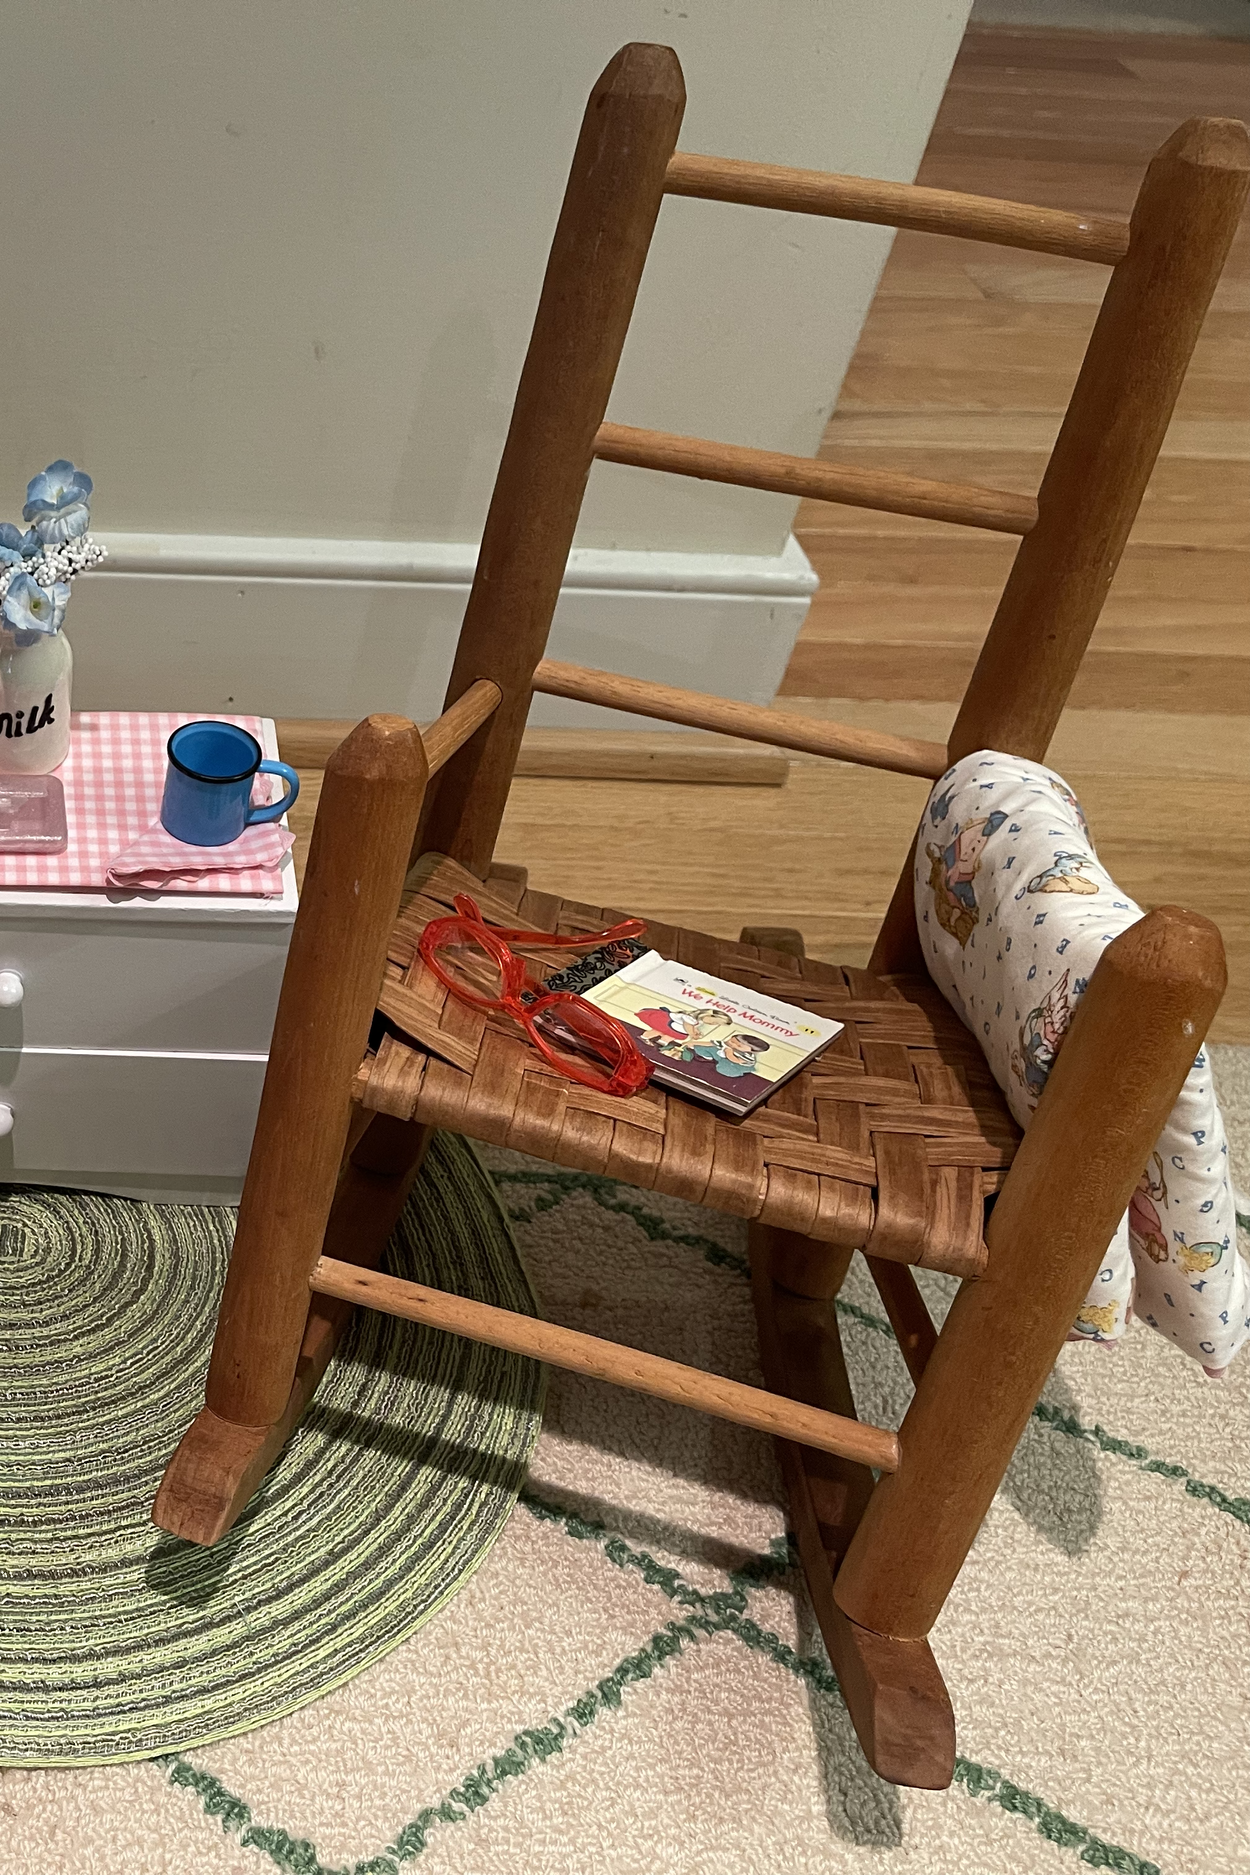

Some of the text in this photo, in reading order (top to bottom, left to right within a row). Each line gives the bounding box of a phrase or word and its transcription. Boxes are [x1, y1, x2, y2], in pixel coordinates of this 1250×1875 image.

[681, 987, 801, 1038] We Help Mommy
